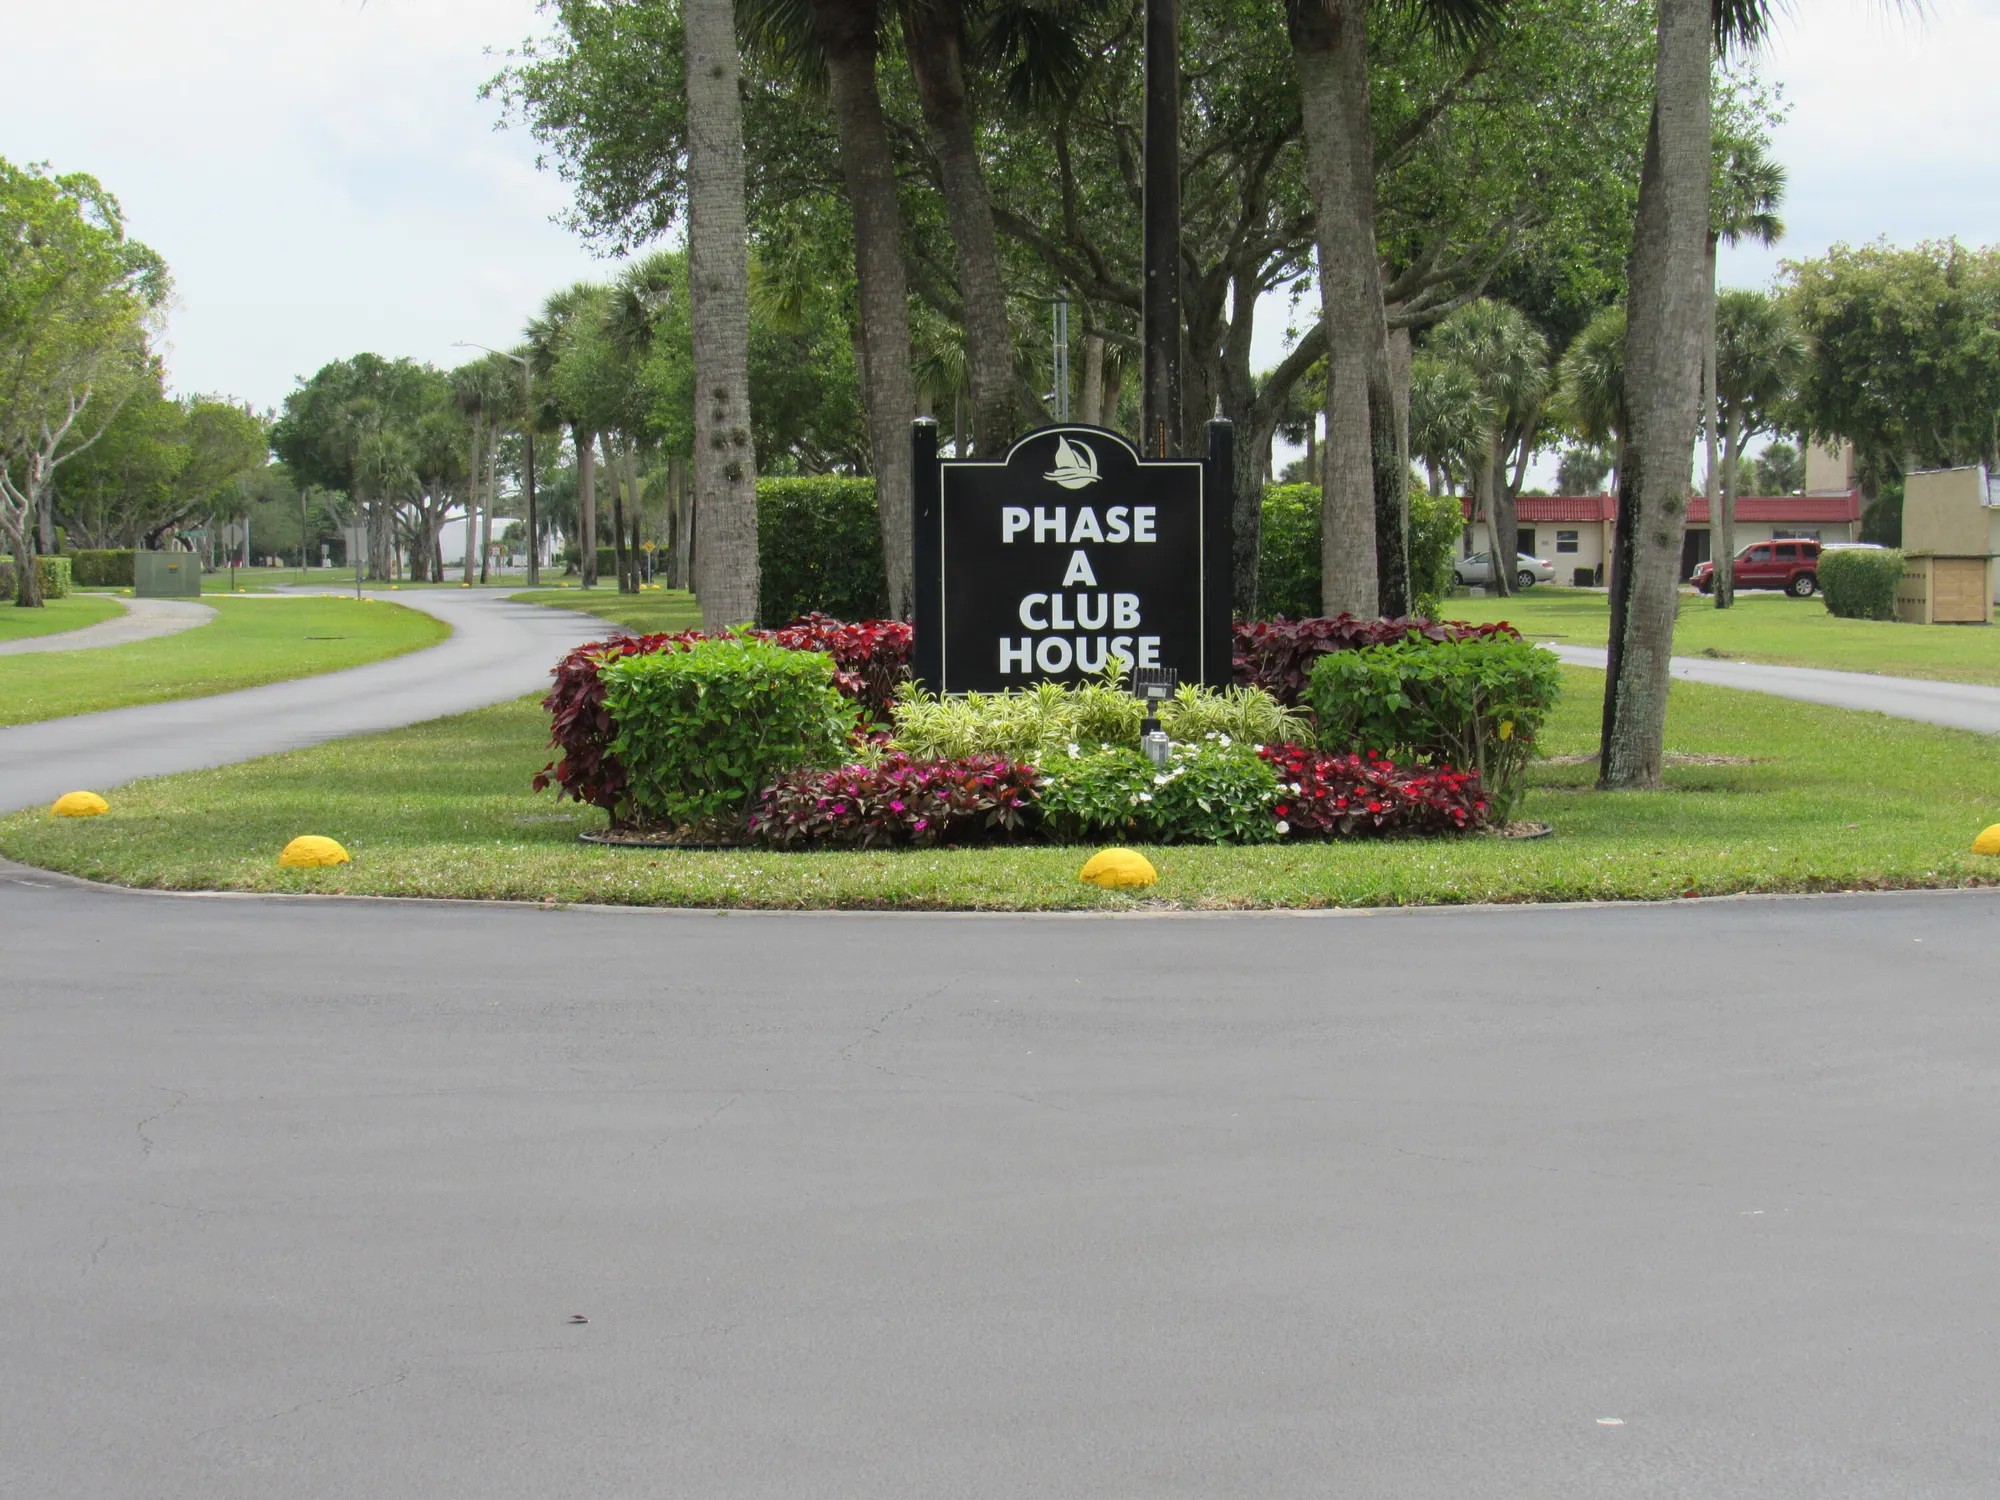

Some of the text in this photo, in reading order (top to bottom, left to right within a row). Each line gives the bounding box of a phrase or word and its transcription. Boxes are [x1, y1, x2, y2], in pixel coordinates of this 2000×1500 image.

[1002, 506, 1157, 543] PHASE
[1062, 550, 1098, 587] A
[1018, 593, 1141, 631] CLUB
[999, 636, 1161, 674] HOUSE
